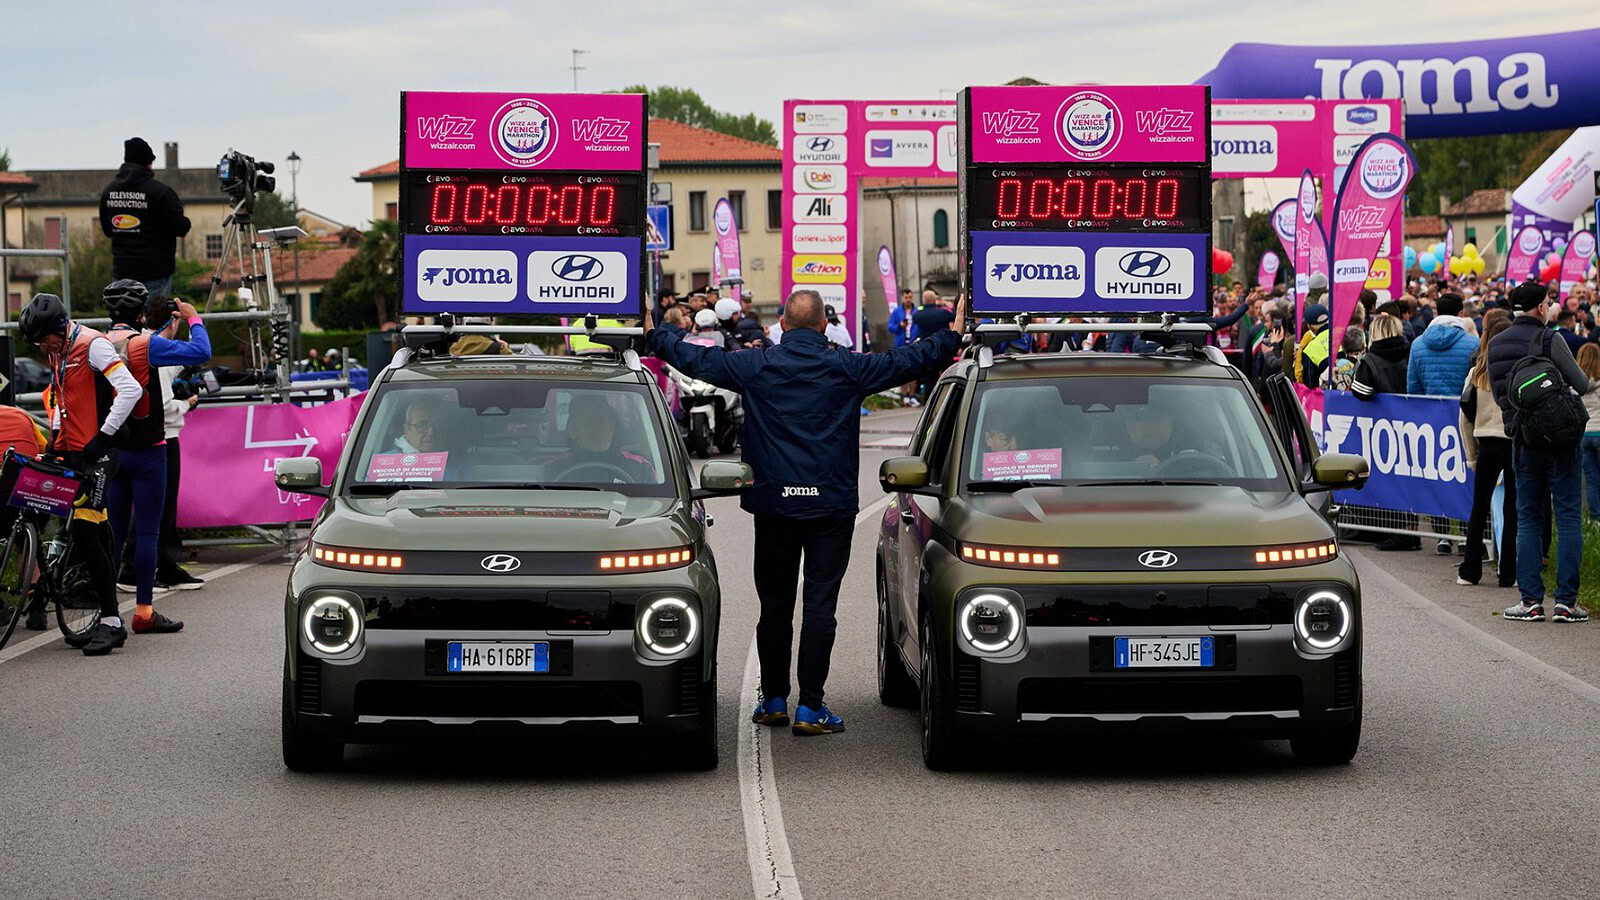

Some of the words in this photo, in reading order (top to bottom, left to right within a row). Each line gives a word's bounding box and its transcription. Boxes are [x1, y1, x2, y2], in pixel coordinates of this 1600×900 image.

[996, 136, 1041, 144] wizzair.com
[1149, 135, 1194, 143] wizzair.com
[430, 142, 476, 150] wizzair.com
[584, 143, 630, 152] wizzair.com
[811, 172, 832, 182] Dole
[109, 191, 146, 200] TELEVISION
[998, 180, 1178, 218] 00:00:00
[107, 200, 148, 209] PRODUCTION
[431, 185, 615, 224] 00:00:00
[1348, 232, 1385, 240] wizzair.com
[539, 286, 614, 299] HYUNDAI
[1107, 282, 1182, 295] HYUNDAI
[27, 501, 51, 510] VENEZIA
